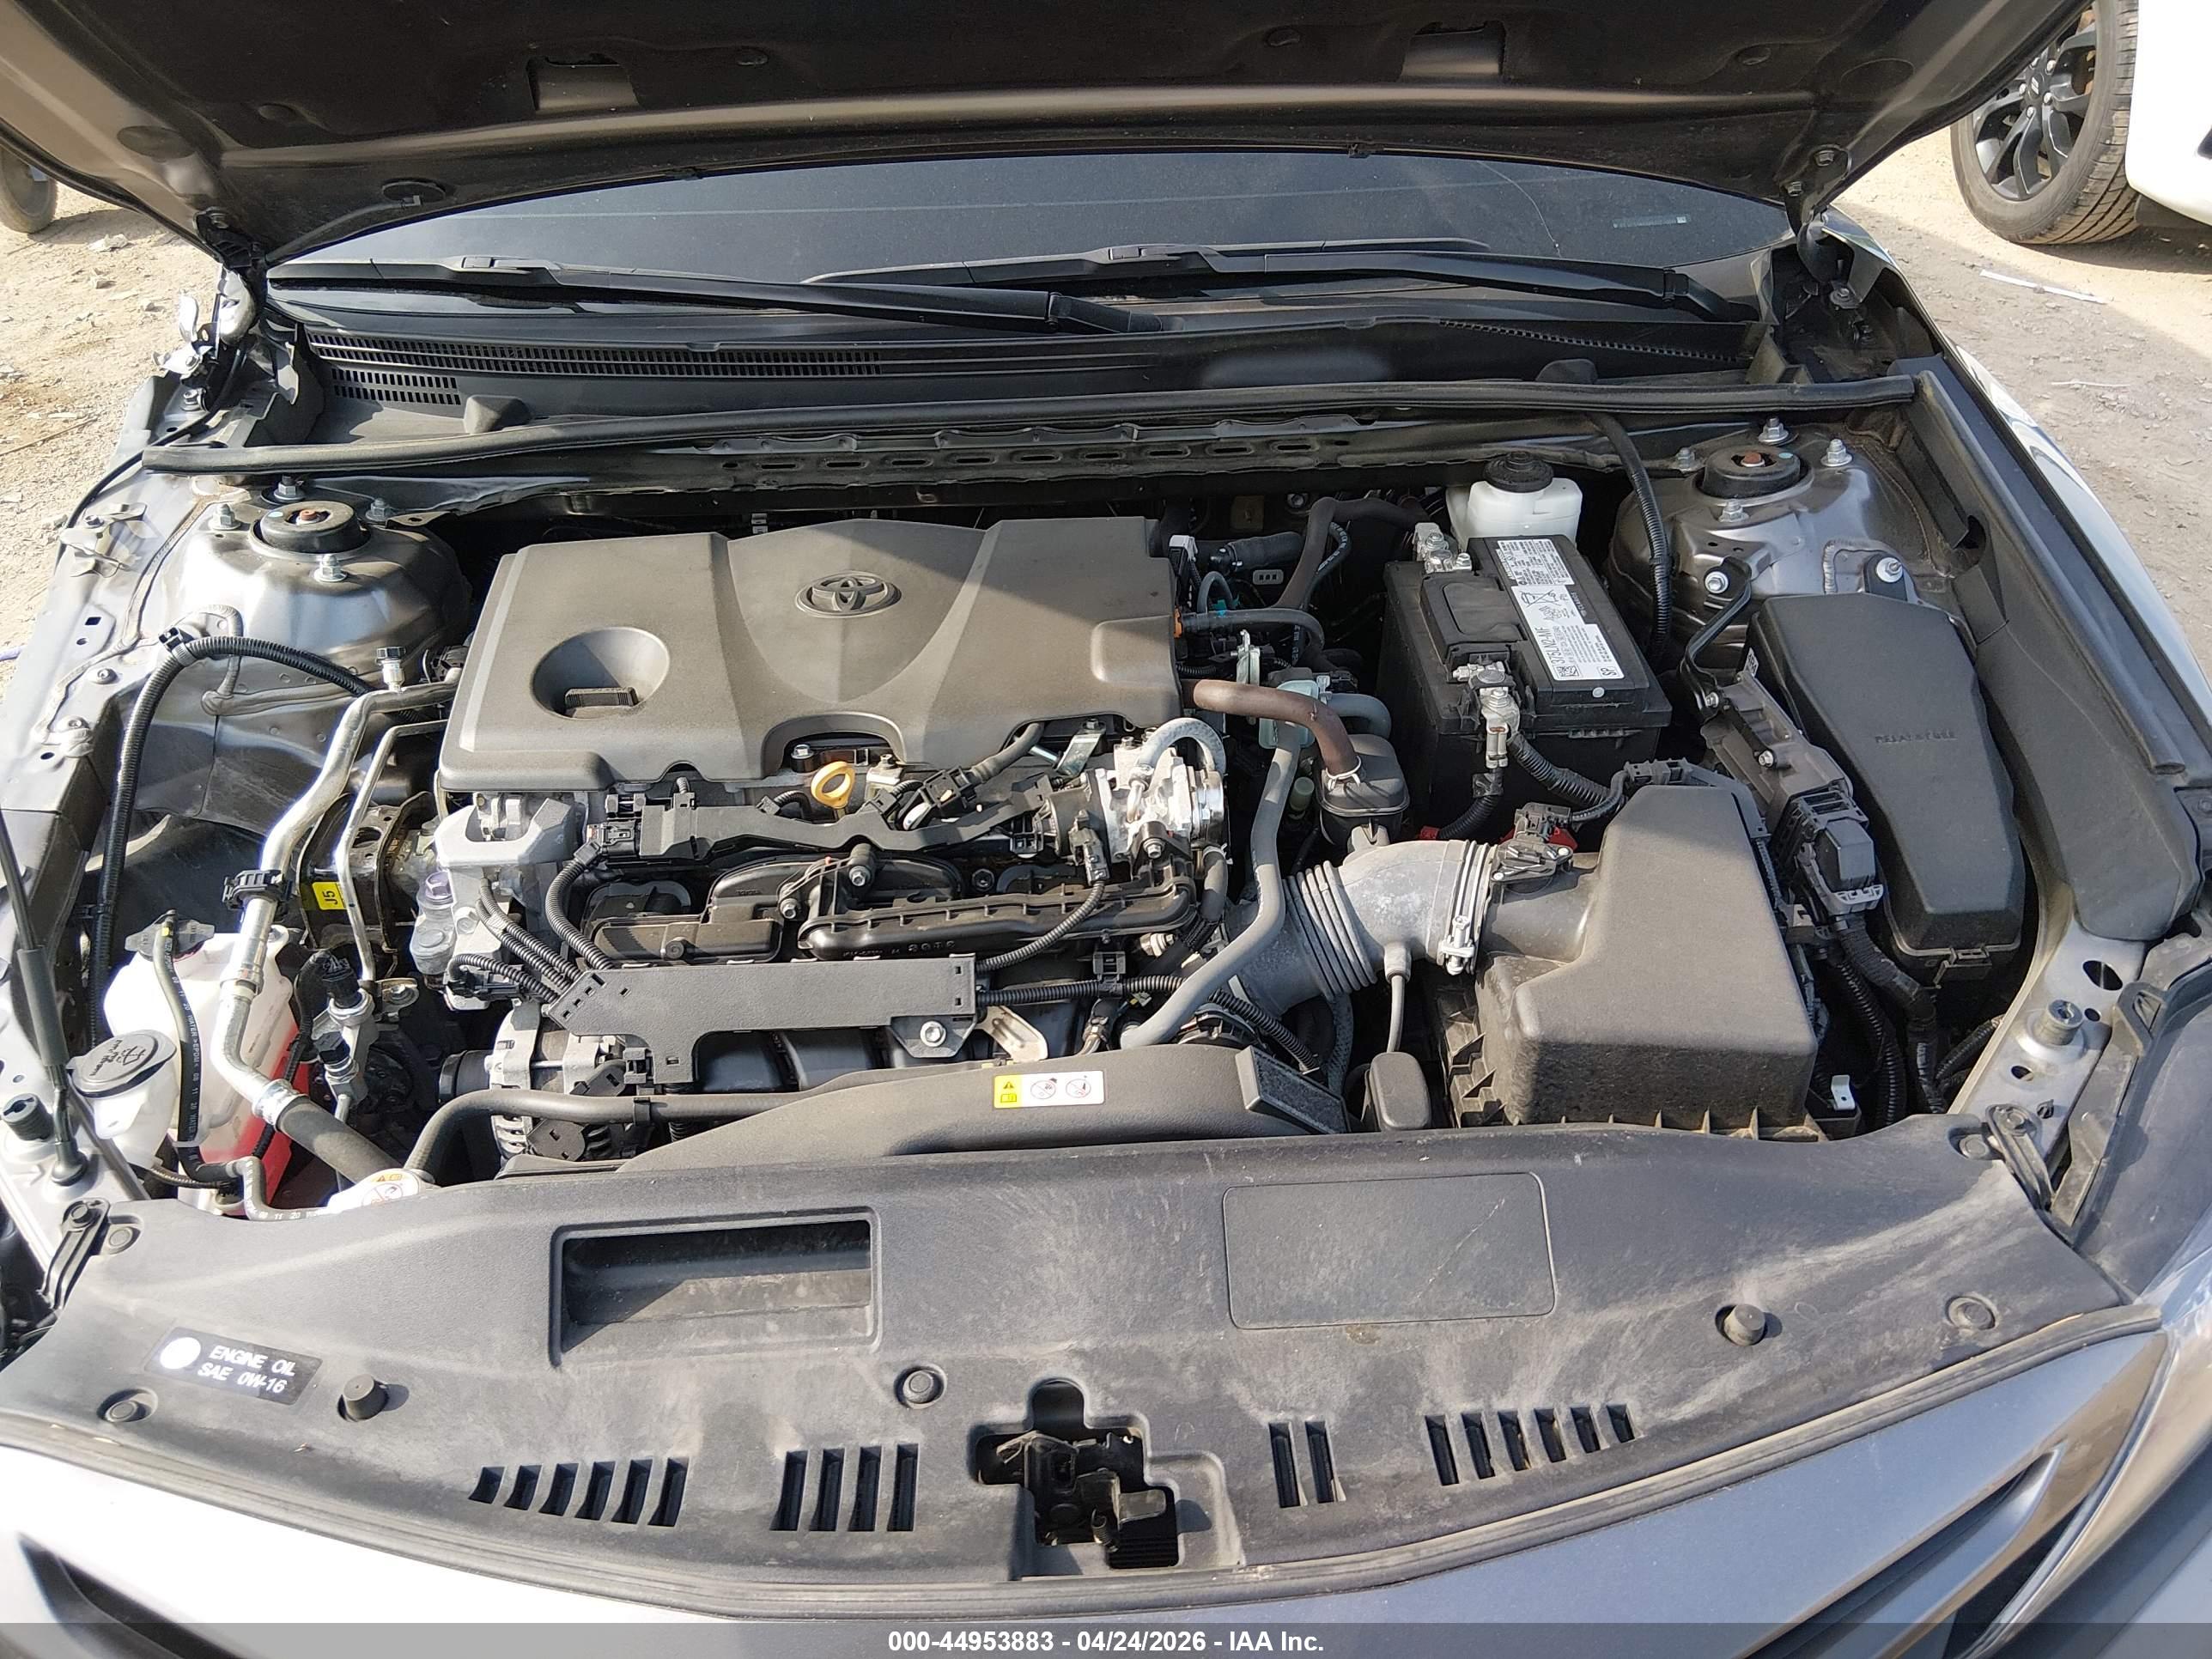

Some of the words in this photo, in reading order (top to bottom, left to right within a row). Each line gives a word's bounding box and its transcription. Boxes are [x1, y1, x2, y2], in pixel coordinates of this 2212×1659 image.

[1534, 627, 1565, 665] 375LN2-MF
[1600, 667, 1617, 676] SP
[322, 890, 338, 905] J5
[188, 1014, 198, 1036] WATER
[209, 1345, 268, 1369] ENGINE
[271, 1358, 297, 1377] OIL
[197, 1363, 234, 1382] SAE
[237, 1371, 289, 1394] 0W-16
